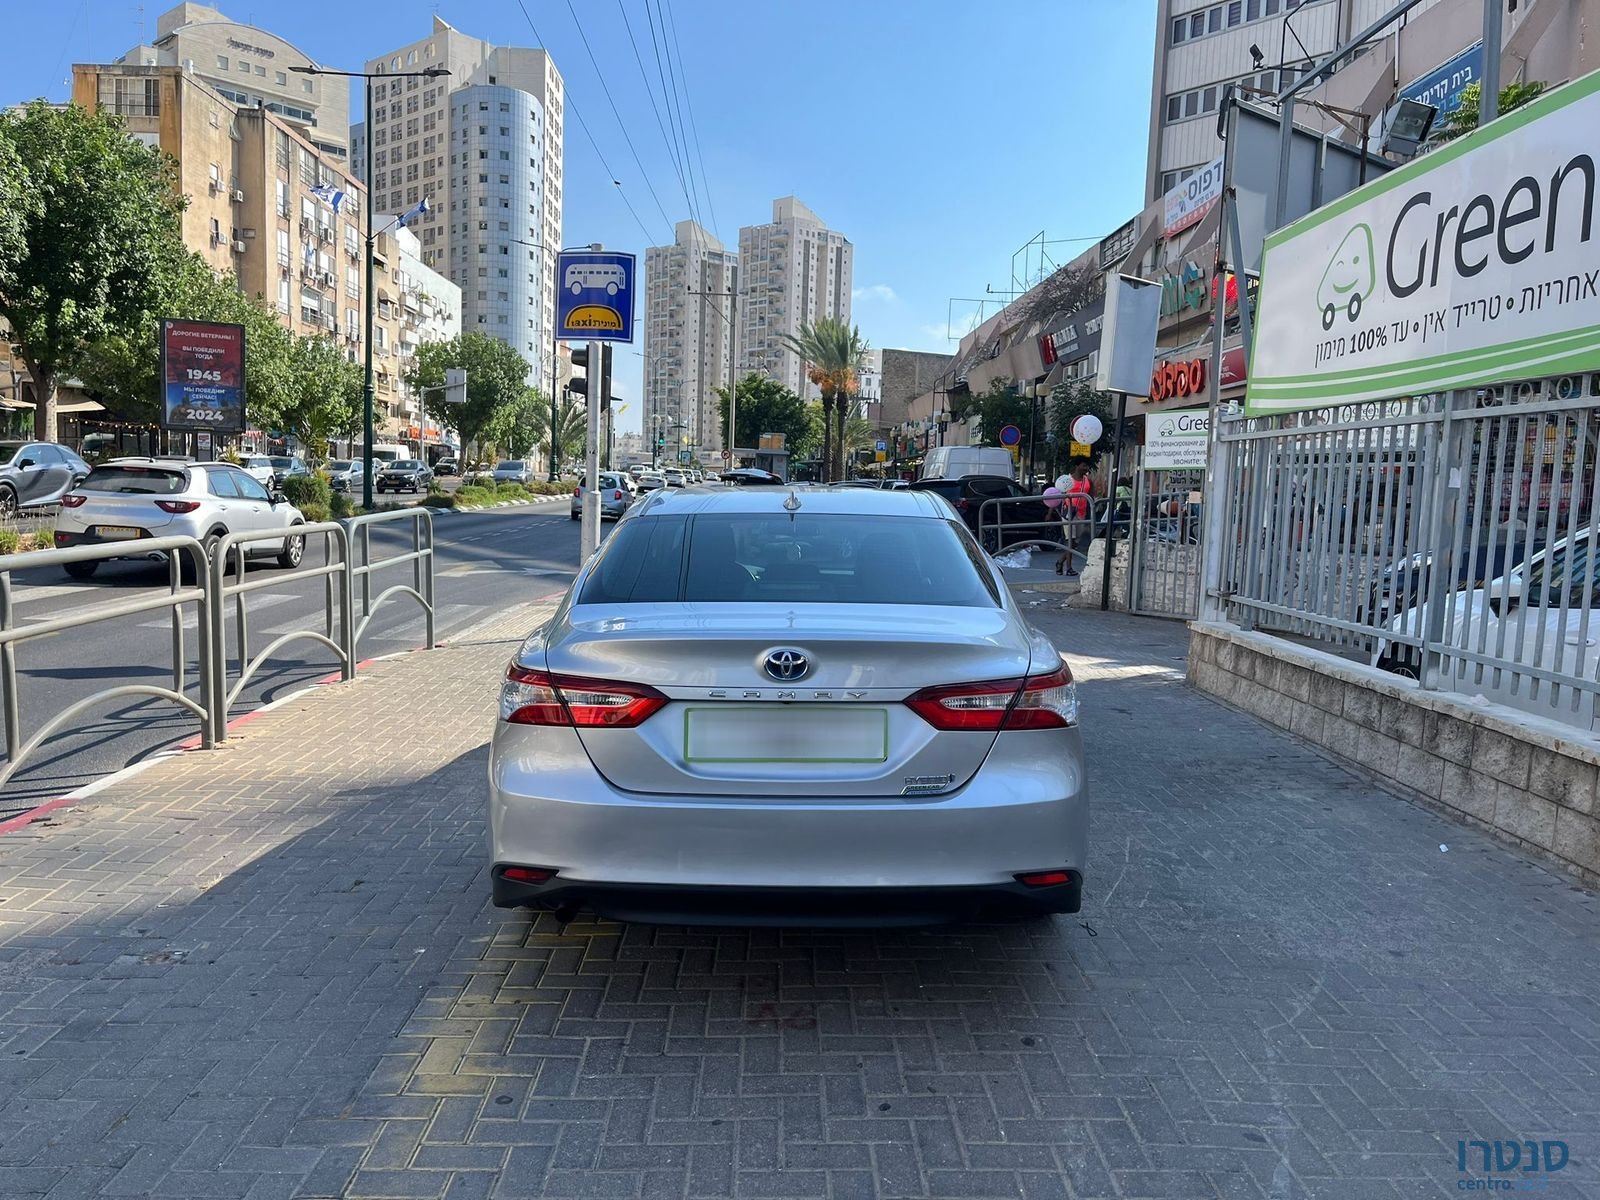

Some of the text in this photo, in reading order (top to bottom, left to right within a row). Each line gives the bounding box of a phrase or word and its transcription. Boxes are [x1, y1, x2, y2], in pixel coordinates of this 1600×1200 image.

[1452, 66, 1472, 88] בית
[1188, 161, 1223, 201] דפוס
[1386, 153, 1596, 298] Green
[571, 313, 617, 328] taxi מונית
[1314, 269, 1600, 368] אחריות טרייד אין עד 100% מימון
[193, 346, 225, 354] ПОБЕДИЛИ
[186, 368, 221, 381] 1945
[186, 408, 224, 421] 2024
[708, 689, 868, 700] CAMRY
